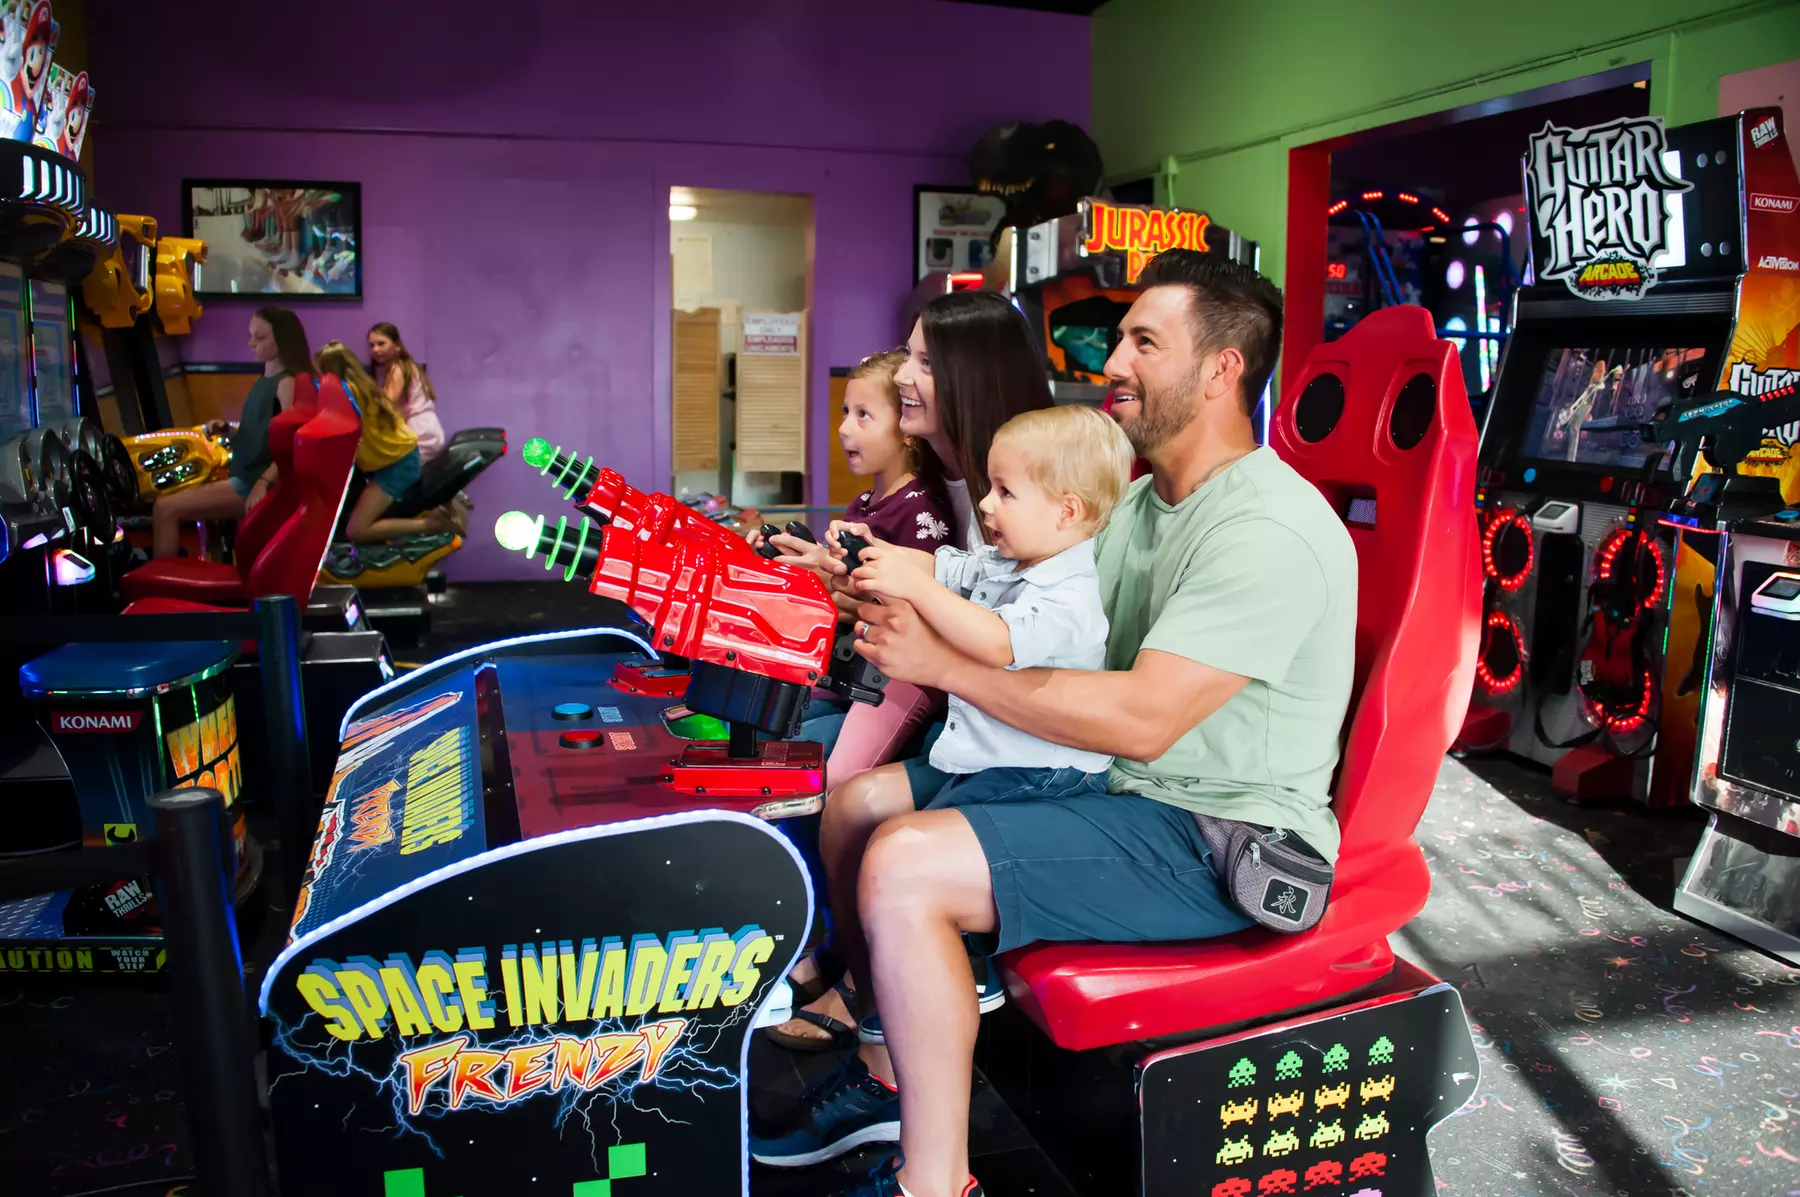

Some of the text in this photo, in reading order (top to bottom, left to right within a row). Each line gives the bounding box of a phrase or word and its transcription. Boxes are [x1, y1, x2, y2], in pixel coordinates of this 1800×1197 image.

[1750, 116, 1776, 141] RAW
[1754, 196, 1793, 210] KONAMI
[1085, 202, 1211, 253] JURASSIC
[1578, 261, 1641, 287] ARCADE
[1683, 399, 1734, 419] TERMINATOR
[1745, 447, 1785, 461] ARCADE
[59, 715, 132, 730] KONAMI
[104, 879, 142, 911] RAW
[112, 892, 148, 918] THRILLS
[110, 949, 150, 957] WATCH
[296, 950, 496, 1042] SPACE
[500, 928, 776, 1028] INVADERS
[400, 1019, 687, 1116] FRENZY
